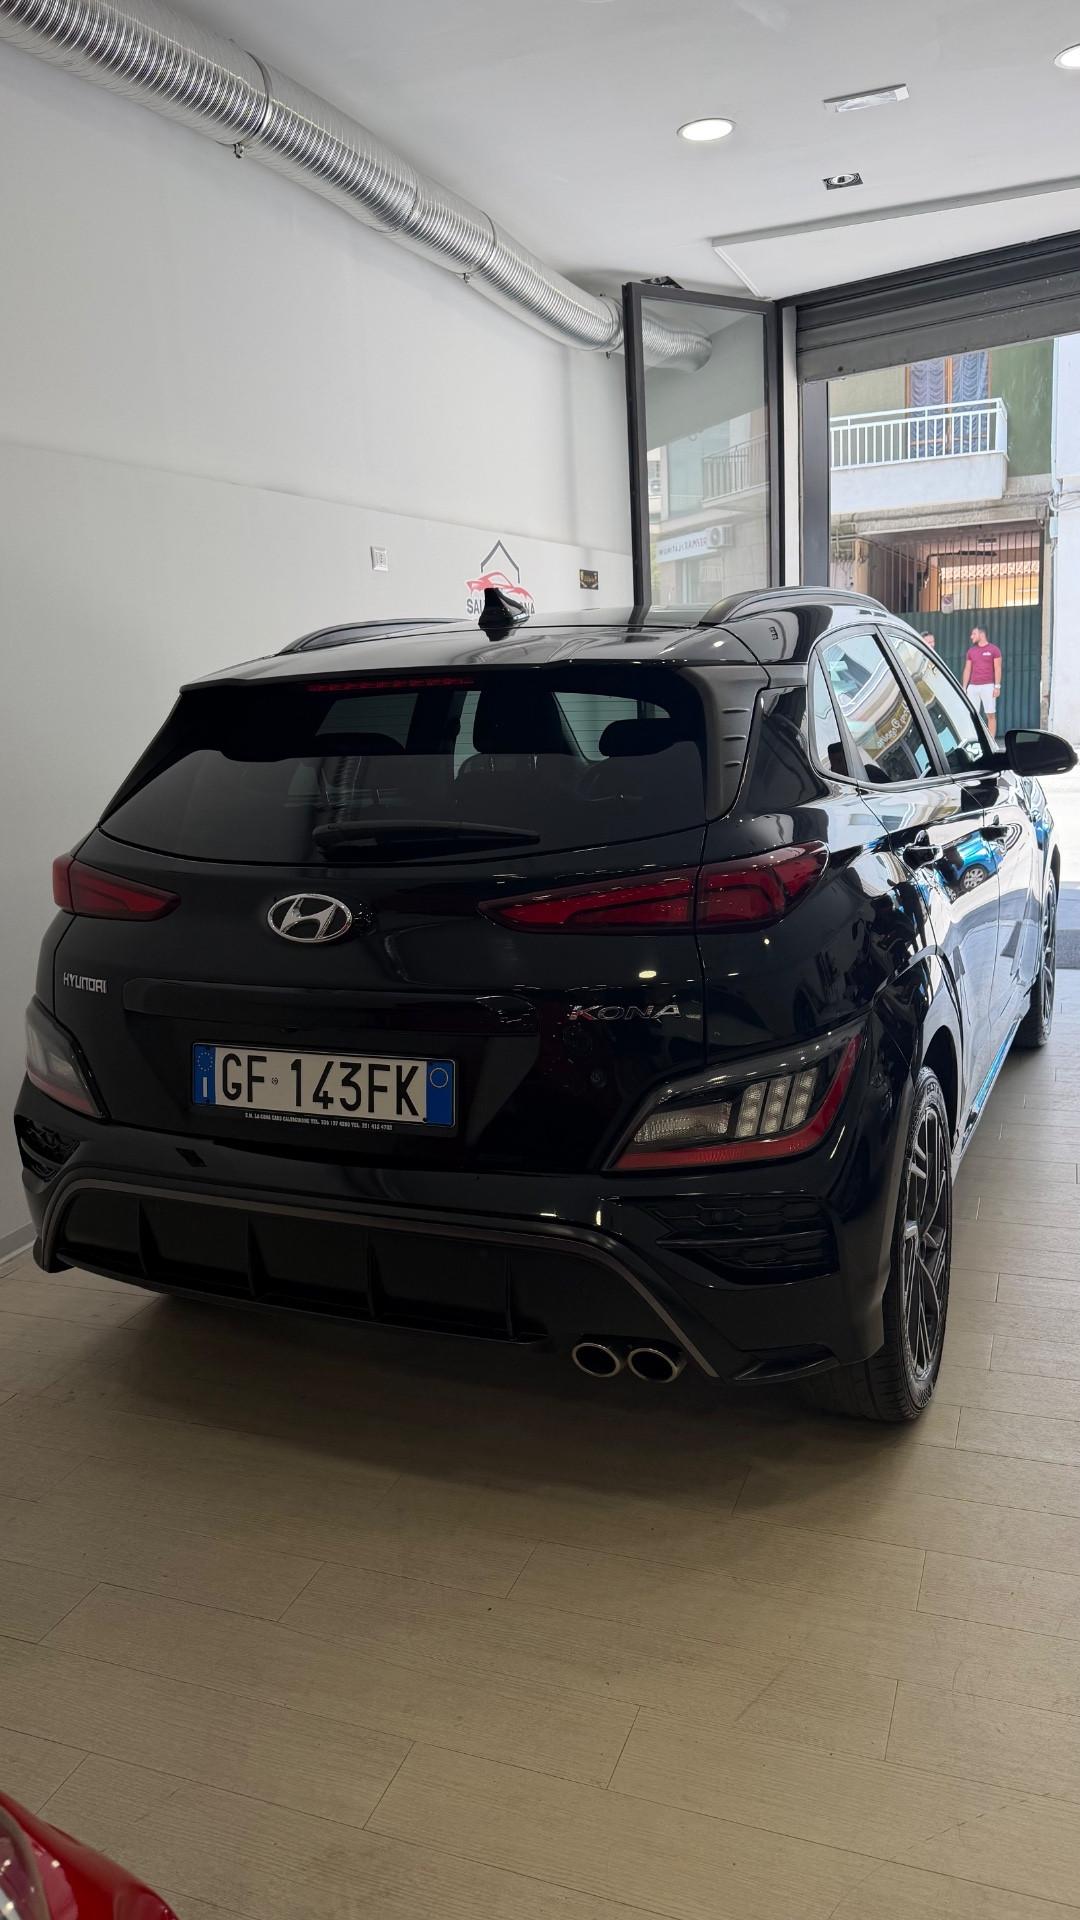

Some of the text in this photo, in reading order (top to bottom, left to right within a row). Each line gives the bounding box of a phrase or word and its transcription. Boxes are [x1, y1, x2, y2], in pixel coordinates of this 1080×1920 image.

[63, 971, 107, 993] HYUNDAI
[568, 1004, 681, 1020] KONA
[222, 1053, 419, 1117] GF 143FK
